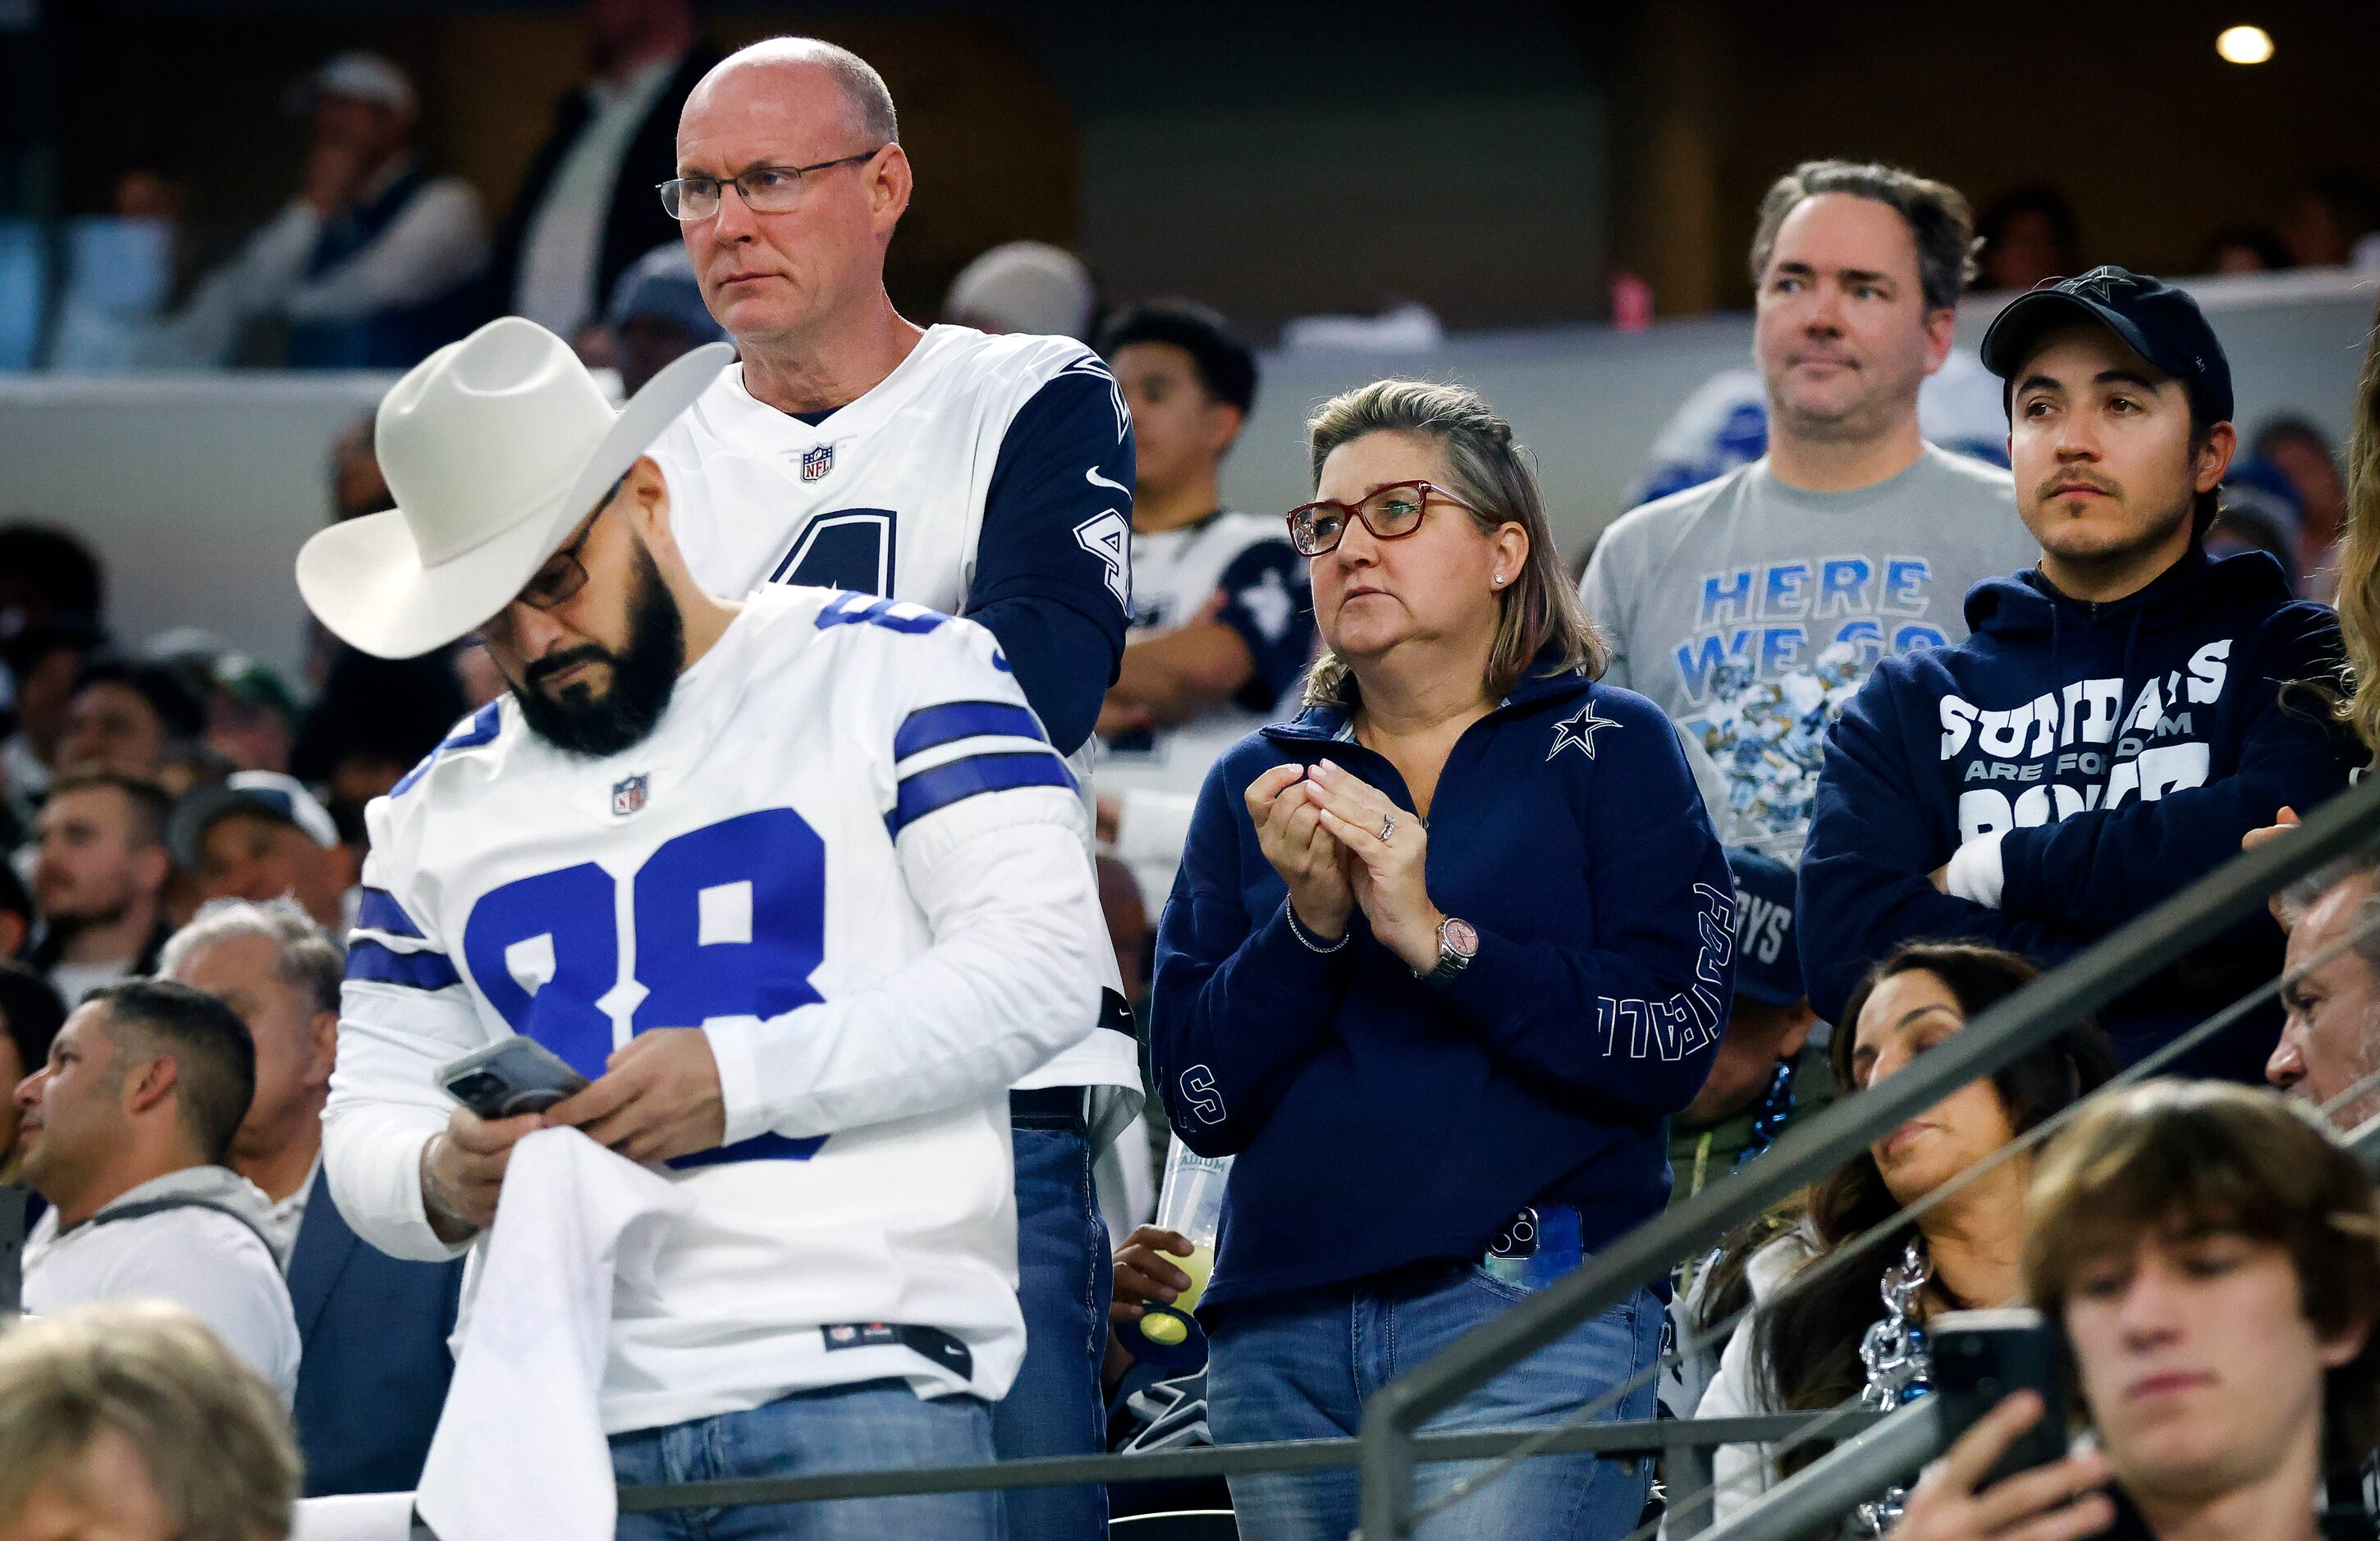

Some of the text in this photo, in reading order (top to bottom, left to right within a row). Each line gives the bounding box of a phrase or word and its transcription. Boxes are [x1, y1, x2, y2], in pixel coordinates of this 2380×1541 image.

[805, 460, 830, 480] NFL
[1073, 507, 1133, 615] 4
[1693, 555, 1933, 633] HERE
[1671, 624, 1809, 706] WE
[1938, 638, 2234, 761] SUNDAS
[1965, 760, 2044, 782] ARE
[2115, 711, 2194, 757] DM
[463, 806, 830, 1168] 88
